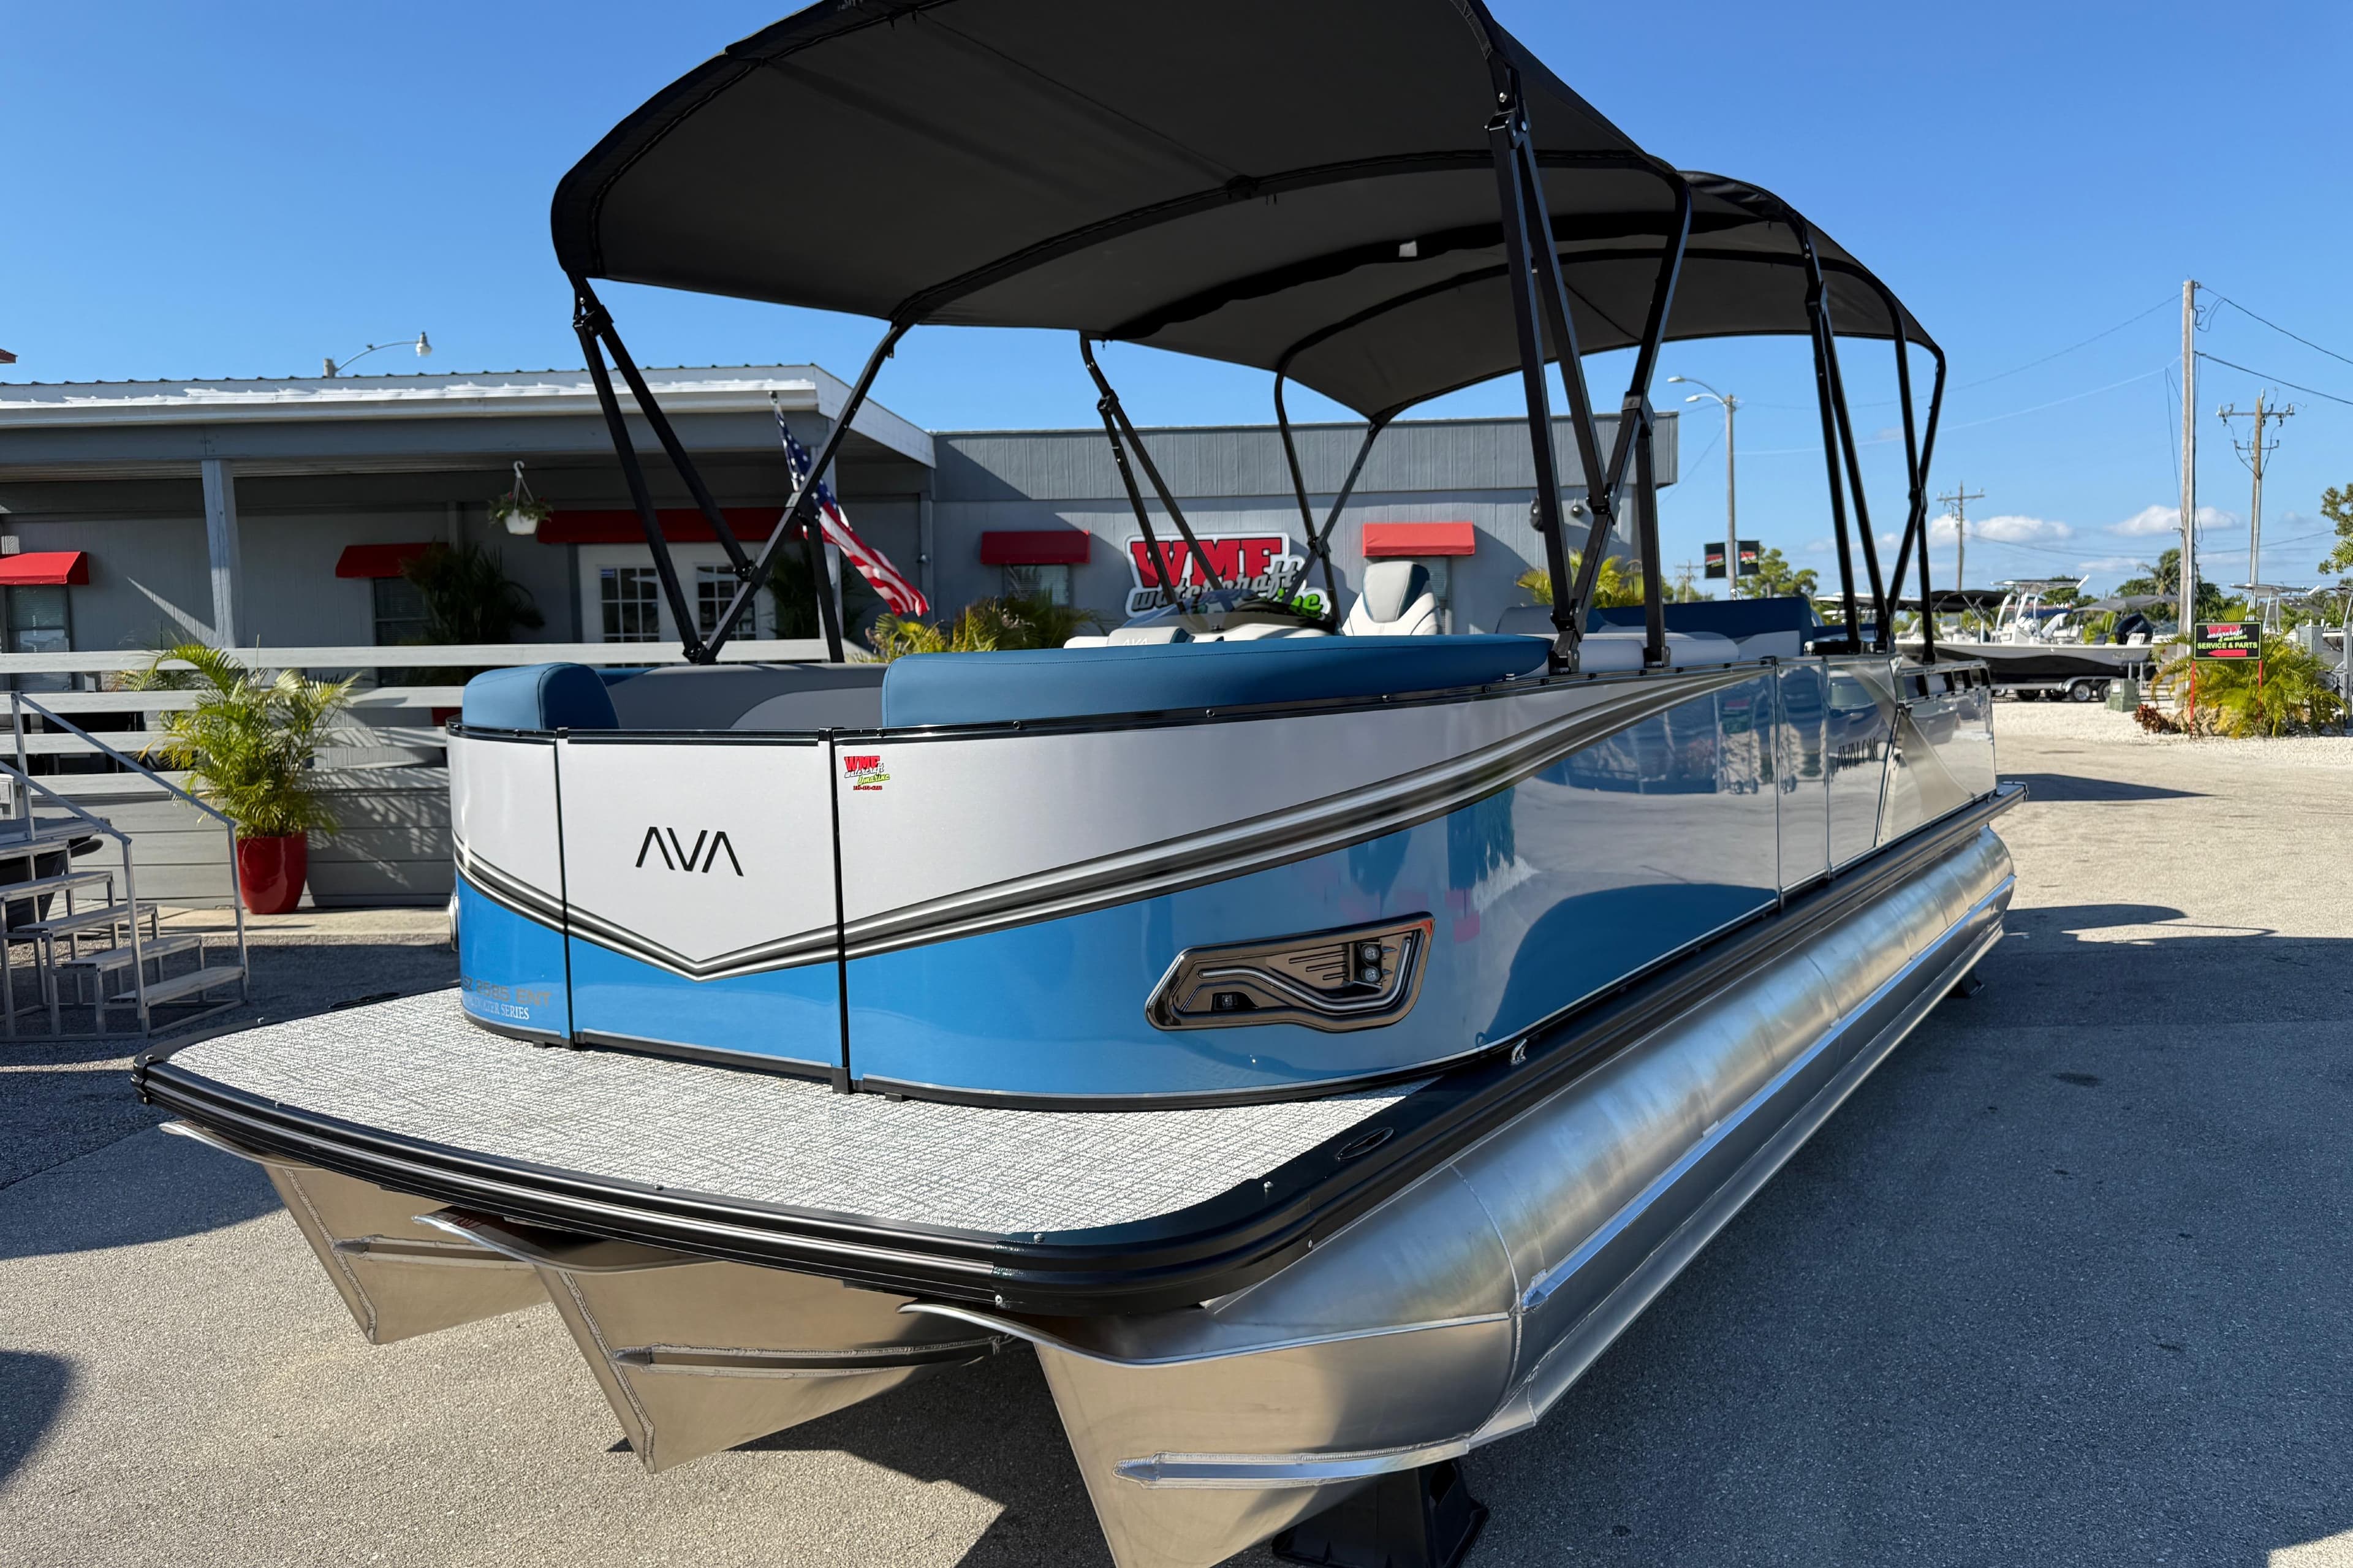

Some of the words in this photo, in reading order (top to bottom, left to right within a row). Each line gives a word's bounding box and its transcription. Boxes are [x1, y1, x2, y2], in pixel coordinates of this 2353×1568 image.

[1131, 537, 1282, 588] WMF
[844, 756, 881, 772] WMF
[1836, 737, 1877, 773] AVALON
[635, 826, 744, 877] AVA
[515, 987, 551, 1007] ENT
[501, 1004, 530, 1020] SERIES
